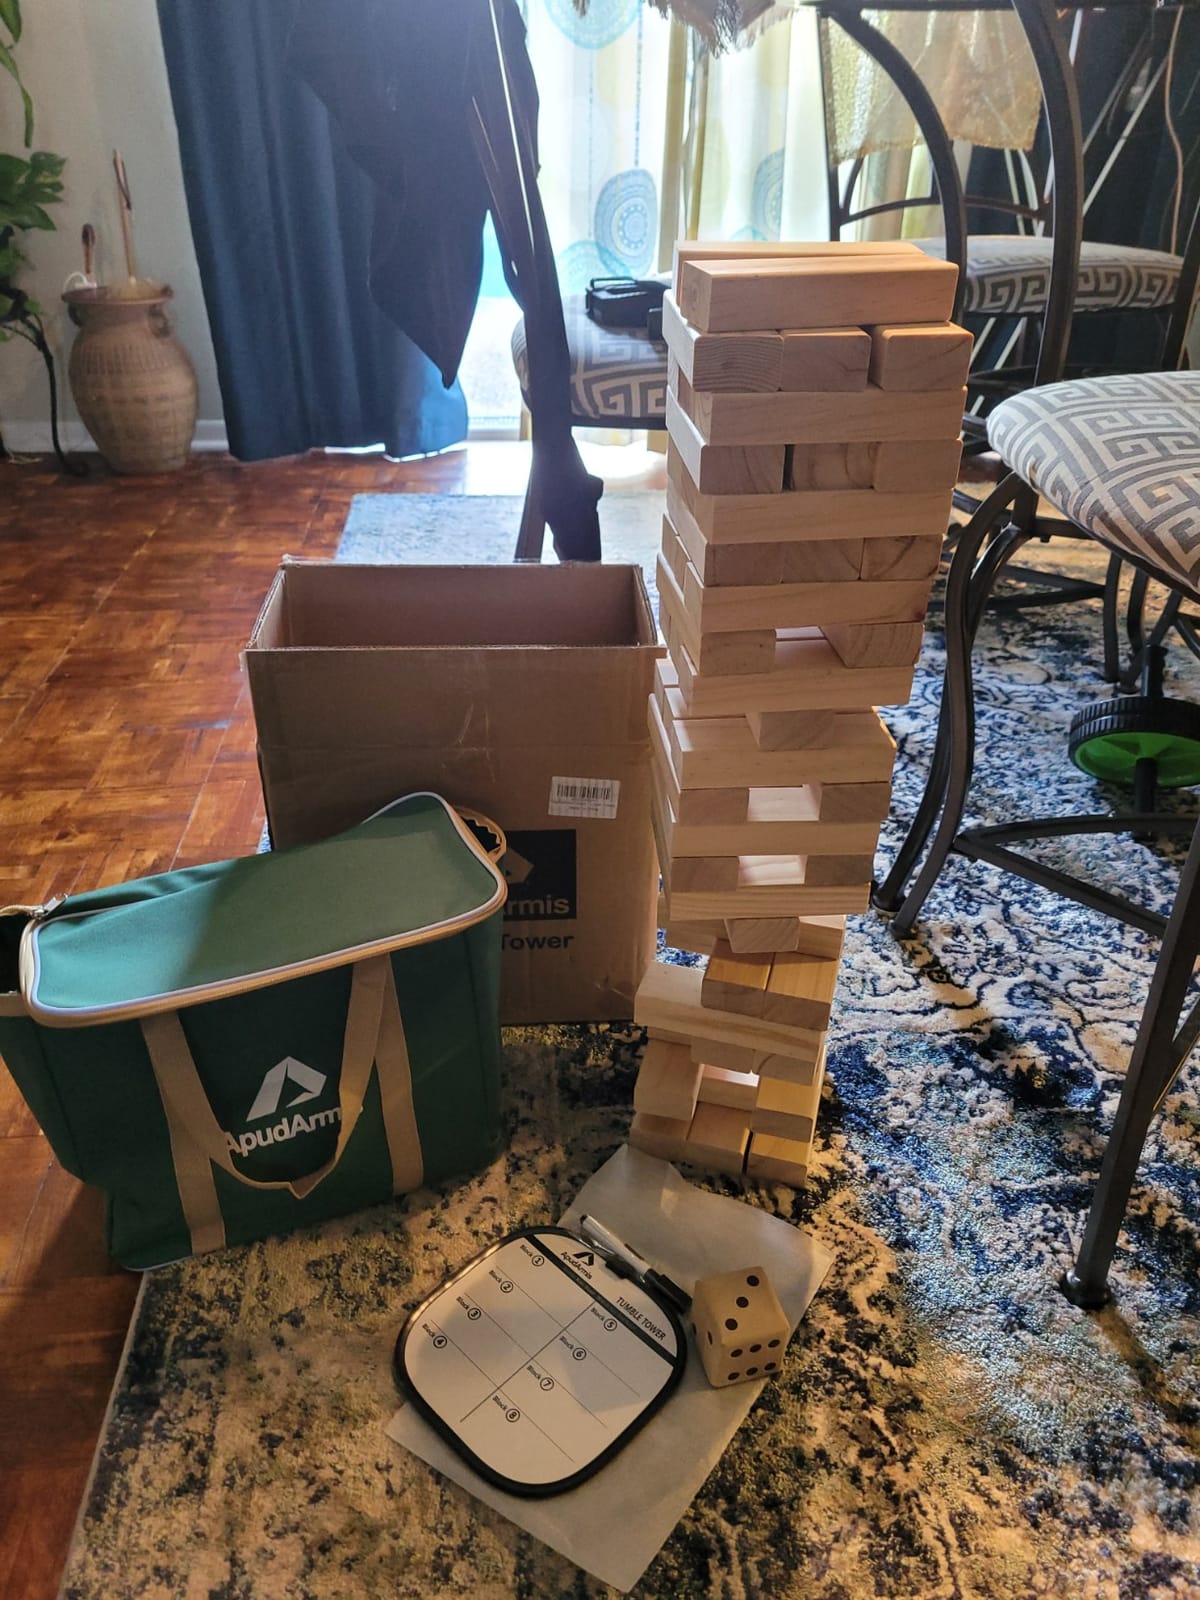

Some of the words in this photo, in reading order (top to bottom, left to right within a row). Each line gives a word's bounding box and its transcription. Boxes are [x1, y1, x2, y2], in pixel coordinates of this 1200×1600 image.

[504, 894, 570, 914] rmis
[502, 934, 575, 951] Tower
[225, 1107, 364, 1157] ApudArm
[561, 1251, 593, 1280] ApudArmis
[616, 1296, 643, 1322] TUMBLE
[641, 1318, 666, 1341] TOWER
